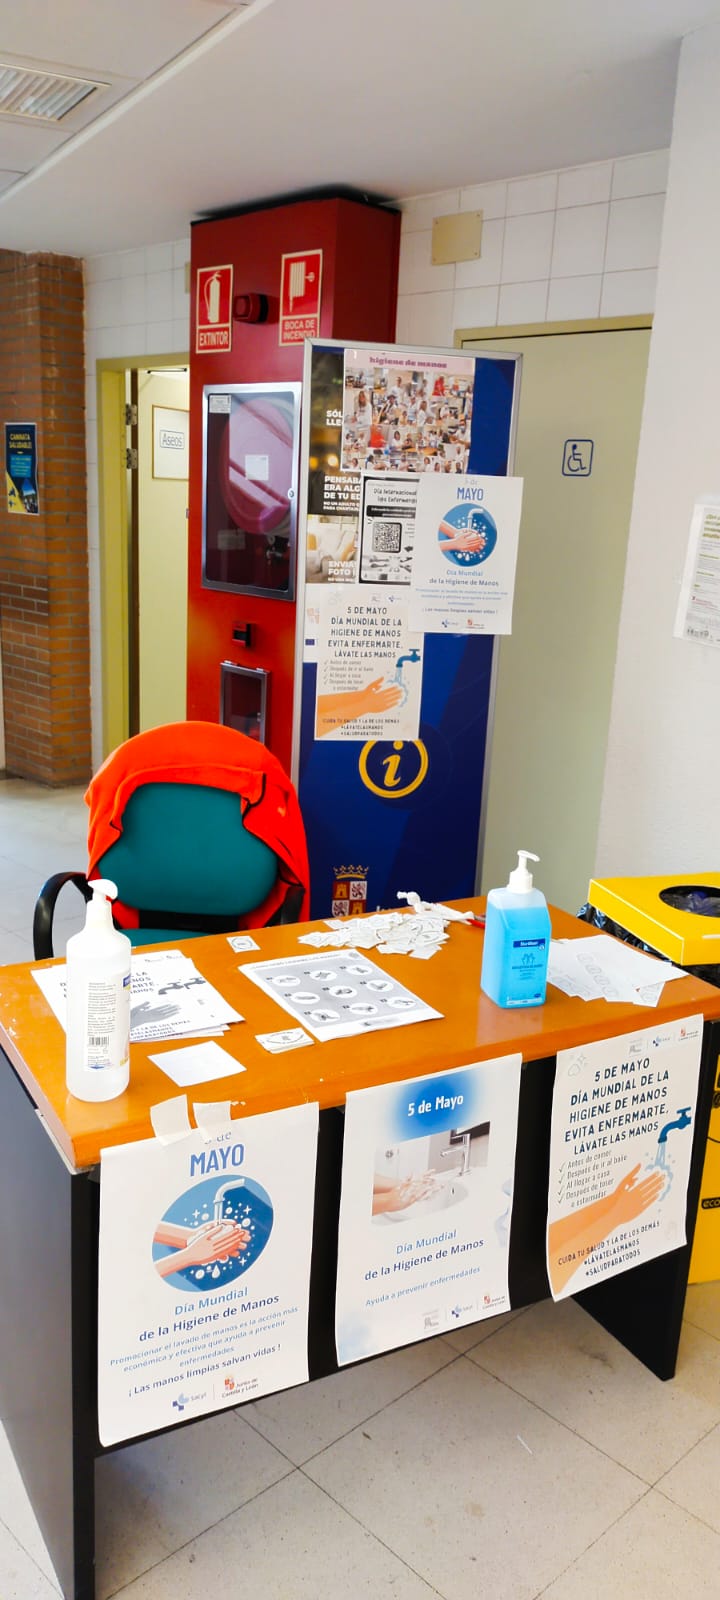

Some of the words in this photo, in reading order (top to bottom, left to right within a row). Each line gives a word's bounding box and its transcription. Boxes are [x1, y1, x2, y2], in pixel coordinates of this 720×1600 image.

[285, 320, 303, 330] BOCA
[305, 319, 315, 328] DE
[199, 331, 229, 346] EXTINTOR
[283, 330, 315, 340] INCENDIO
[369, 357, 404, 366] higiene
[326, 409, 342, 417] SÓL
[162, 433, 183, 447] Aseos
[324, 492, 335, 500] DE
[343, 484, 360, 492] ALG
[457, 487, 484, 501] MAYO
[347, 606, 352, 614] 5
[354, 606, 364, 614] DE
[366, 607, 387, 615] MAYO
[331, 616, 344, 625] DÍA
[346, 617, 379, 626] MUNDIAL
[381, 618, 391, 626] DE
[331, 628, 360, 637] HIGIENE
[363, 629, 372, 637] DE
[375, 629, 401, 637] MANOS
[328, 639, 349, 647] EVITA
[334, 649, 359, 658] LÁVATE
[374, 650, 396, 658] MANOS
[594, 1070, 601, 1082] 5
[604, 1066, 618, 1080] DE
[621, 1057, 650, 1075] MAYO
[570, 1090, 588, 1106] DÍA
[592, 1081, 637, 1100] MUNDIAL
[641, 1073, 654, 1087] DE
[657, 1069, 669, 1081] LA
[407, 1102, 415, 1117] 5
[418, 1100, 432, 1114] de
[435, 1095, 464, 1111] Mayo
[569, 1101, 611, 1124] HIGIENE
[615, 1097, 628, 1111] DE
[631, 1086, 668, 1106] MANOS
[564, 1124, 595, 1143] EVITA
[574, 1134, 608, 1155] LÁVATE
[610, 1129, 626, 1144] LAS
[628, 1121, 659, 1138] MANOS
[189, 1143, 245, 1177] MAYO
[567, 1158, 584, 1169] Antes
[586, 1154, 593, 1163] de
[592, 1161, 600, 1171] de
[606, 1158, 613, 1166] al
[566, 1180, 573, 1190] Al
[597, 1170, 611, 1179] casa
[396, 1243, 413, 1254] Día
[416, 1229, 457, 1248] Mundial
[558, 1253, 576, 1266] CUIDA
[577, 1249, 585, 1257] TU
[586, 1241, 605, 1255] SALUD
[611, 1236, 619, 1245] LA
[620, 1232, 627, 1241] DE
[628, 1228, 640, 1238] LOS
[640, 1220, 660, 1233] DEMÁS
[364, 1270, 378, 1281] de
[381, 1266, 391, 1276] la
[393, 1254, 433, 1273] Higiene
[435, 1249, 448, 1260] de
[450, 1239, 485, 1255] Manos
[365, 1294, 390, 1307] Ayuda
[397, 1282, 429, 1298] prevenir
[429, 1266, 481, 1287] enfermedades
[174, 1303, 195, 1316] Día
[199, 1287, 248, 1309] Mundial
[138, 1330, 155, 1343] de
[158, 1326, 169, 1337] la
[173, 1312, 220, 1333] Higiene
[222, 1306, 237, 1318] de
[240, 1294, 280, 1313] Manos
[110, 1344, 164, 1367] Promocionar
[164, 1342, 172, 1351] el
[173, 1335, 200, 1349] lavado
[201, 1331, 211, 1341] de
[212, 1324, 239, 1338] manos
[239, 1321, 248, 1330] es
[249, 1317, 257, 1326] la
[257, 1311, 282, 1325] acción
[282, 1306, 299, 1318] más
[123, 1354, 168, 1373] económica
[168, 1353, 174, 1363] y
[175, 1343, 207, 1360] efectiva
[207, 1337, 223, 1350] que
[224, 1330, 247, 1347] ayuda
[254, 1319, 287, 1336] prevenir
[179, 1344, 235, 1368] enfermedades
[133, 1382, 151, 1395] Las
[152, 1373, 184, 1388] manos
[186, 1361, 220, 1380] limpias
[221, 1353, 252, 1369] salvan
[252, 1346, 276, 1360] vidas
